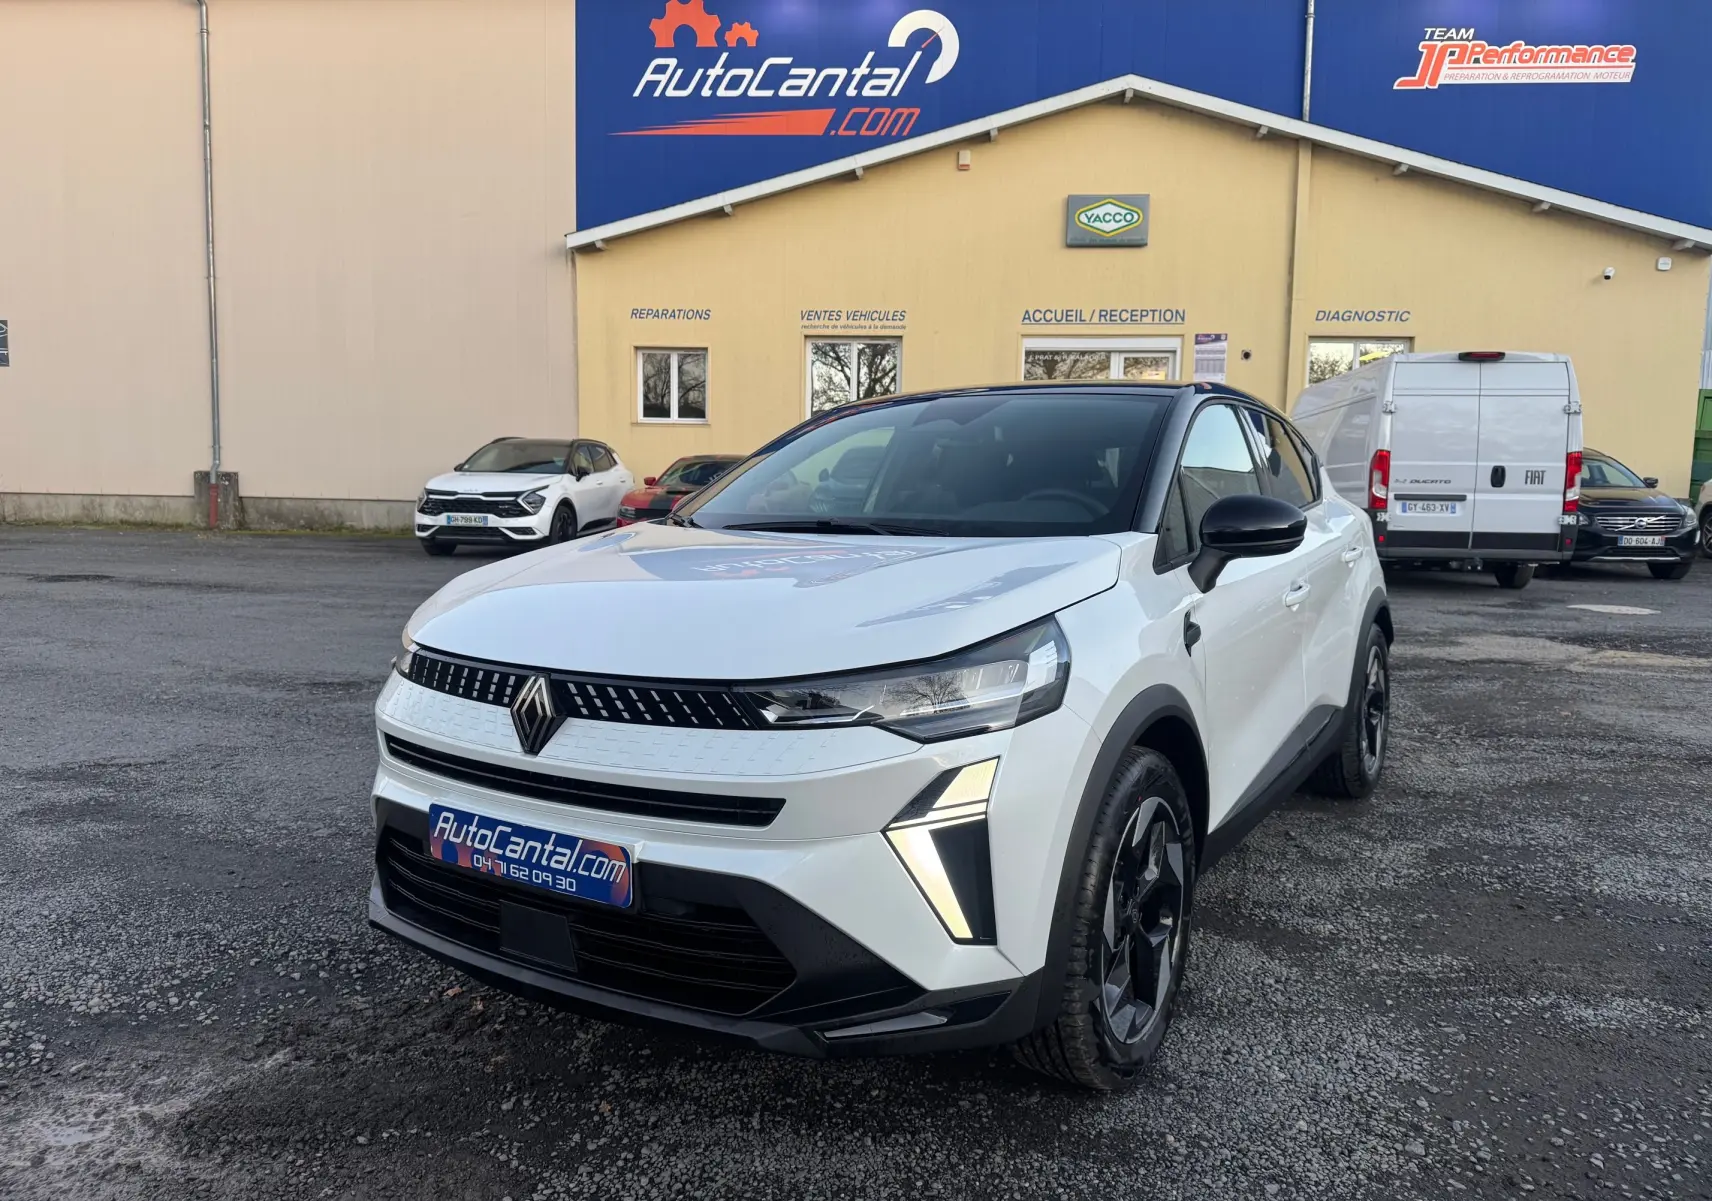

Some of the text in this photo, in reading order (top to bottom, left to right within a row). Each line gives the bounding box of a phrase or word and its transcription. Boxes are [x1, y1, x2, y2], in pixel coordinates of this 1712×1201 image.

[1424, 28, 1475, 40] TEAM
[632, 51, 923, 98] AutoCantal
[1594, 71, 1631, 79] MOTEUR
[1084, 212, 1134, 223] YACCO
[630, 308, 711, 321] REPARATIONS
[800, 310, 906, 321] VENTES VEHICULES
[1021, 309, 1087, 322] ACCUEIL
[1098, 309, 1185, 322] RECEPTION
[1315, 309, 1411, 322] DIAGNOSTIC
[1525, 470, 1546, 485] FIAT
[433, 811, 627, 883] AutoCantal.com
[473, 854, 576, 891] 04 71 62 09 30
